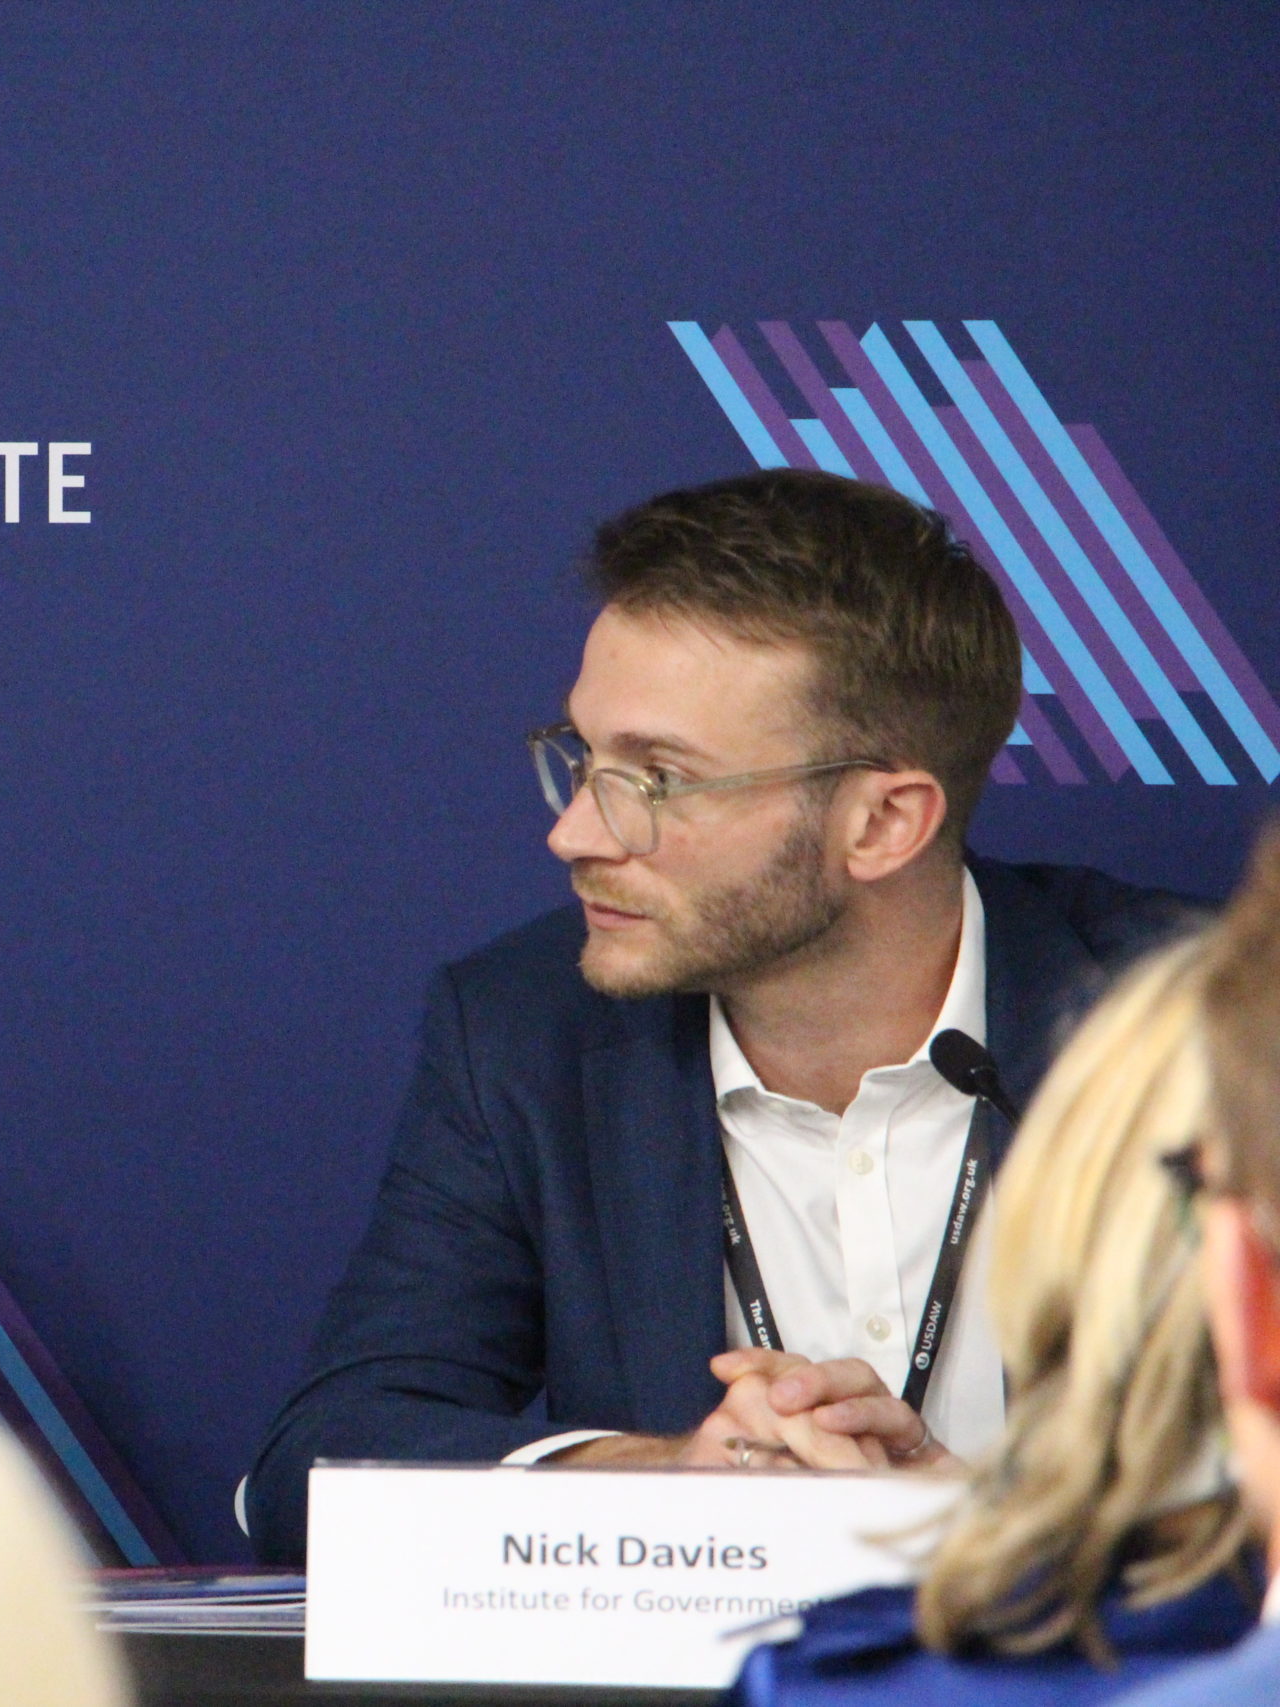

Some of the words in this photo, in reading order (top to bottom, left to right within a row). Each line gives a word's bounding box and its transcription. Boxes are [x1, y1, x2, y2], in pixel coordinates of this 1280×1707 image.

[750, 1298, 763, 1326] The
[921, 1300, 942, 1351] USDAW
[503, 1533, 599, 1567] Nick
[618, 1535, 768, 1570] Davies
[443, 1587, 571, 1612] Institute
[581, 1587, 622, 1612] for
